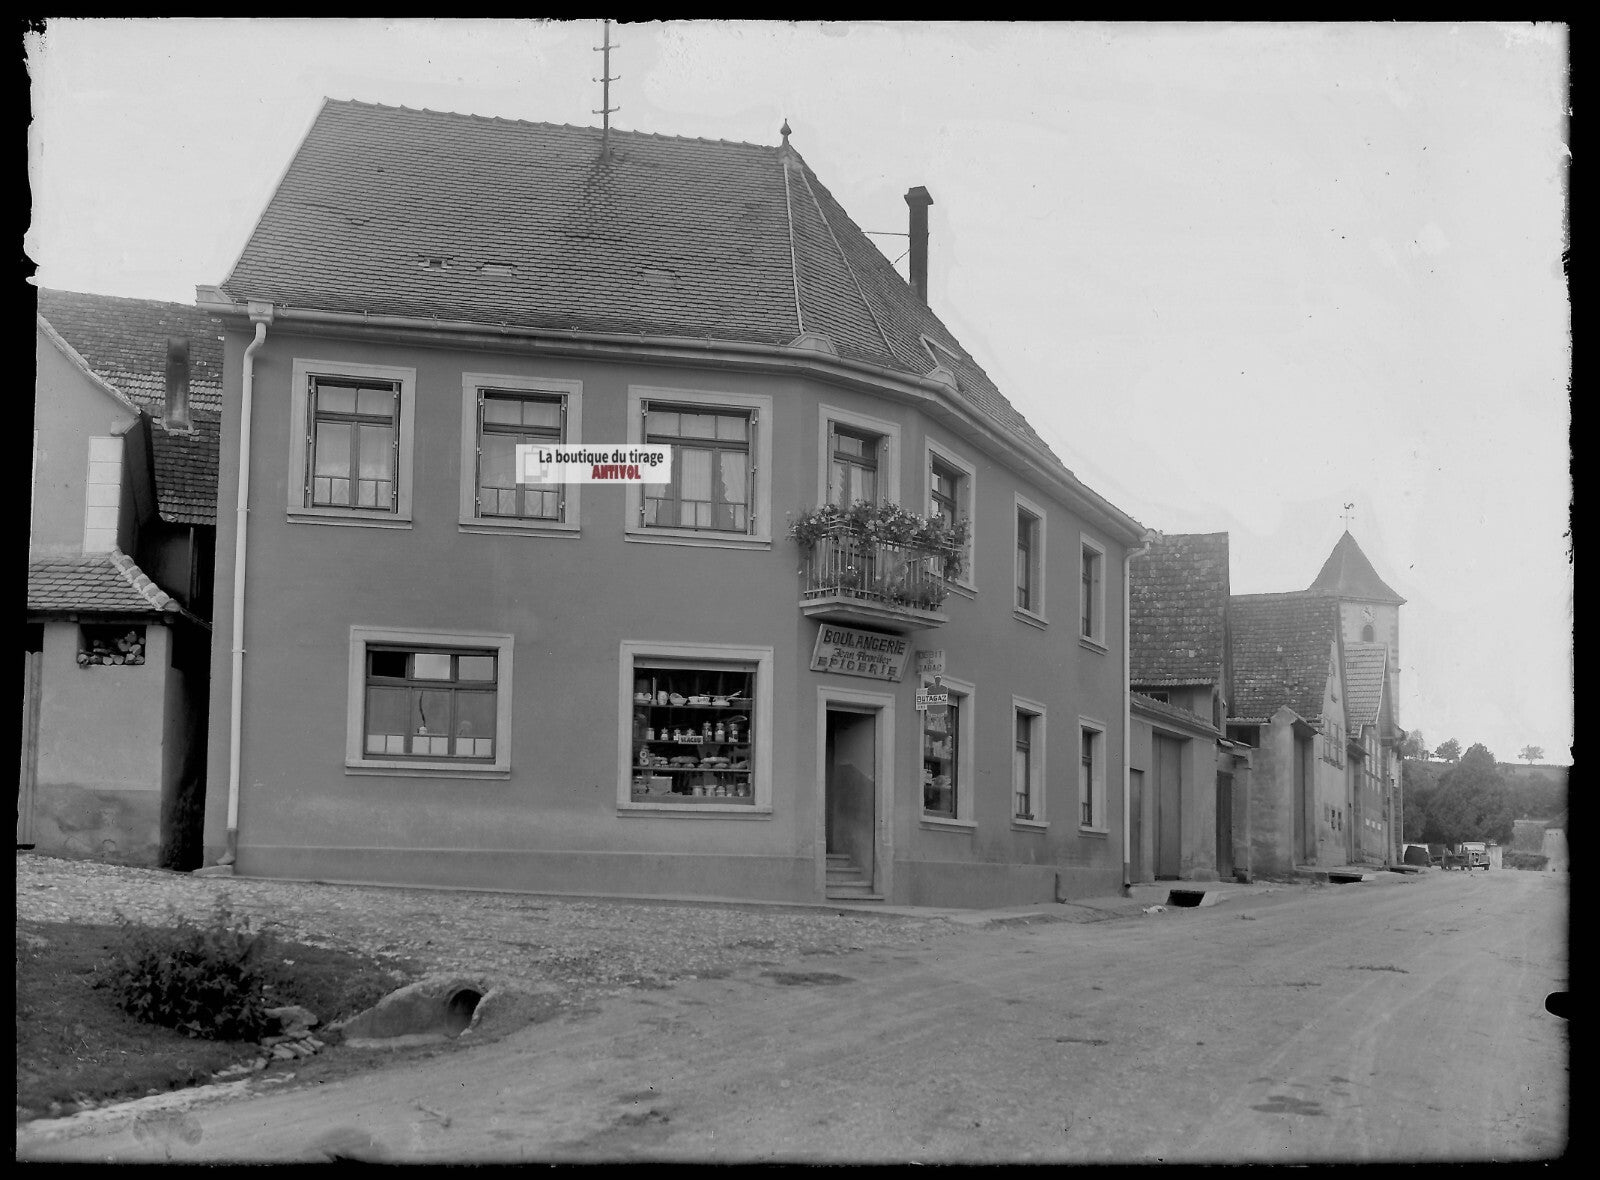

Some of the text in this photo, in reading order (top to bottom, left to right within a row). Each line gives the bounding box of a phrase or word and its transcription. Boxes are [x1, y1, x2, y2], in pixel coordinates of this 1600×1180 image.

[823, 629, 906, 655] BOULANGERIE
[832, 648, 855, 660] Jean
[817, 656, 897, 676] EPICERIE
[919, 664, 942, 672] TABAC
[917, 695, 947, 703] BUTAGAZ
